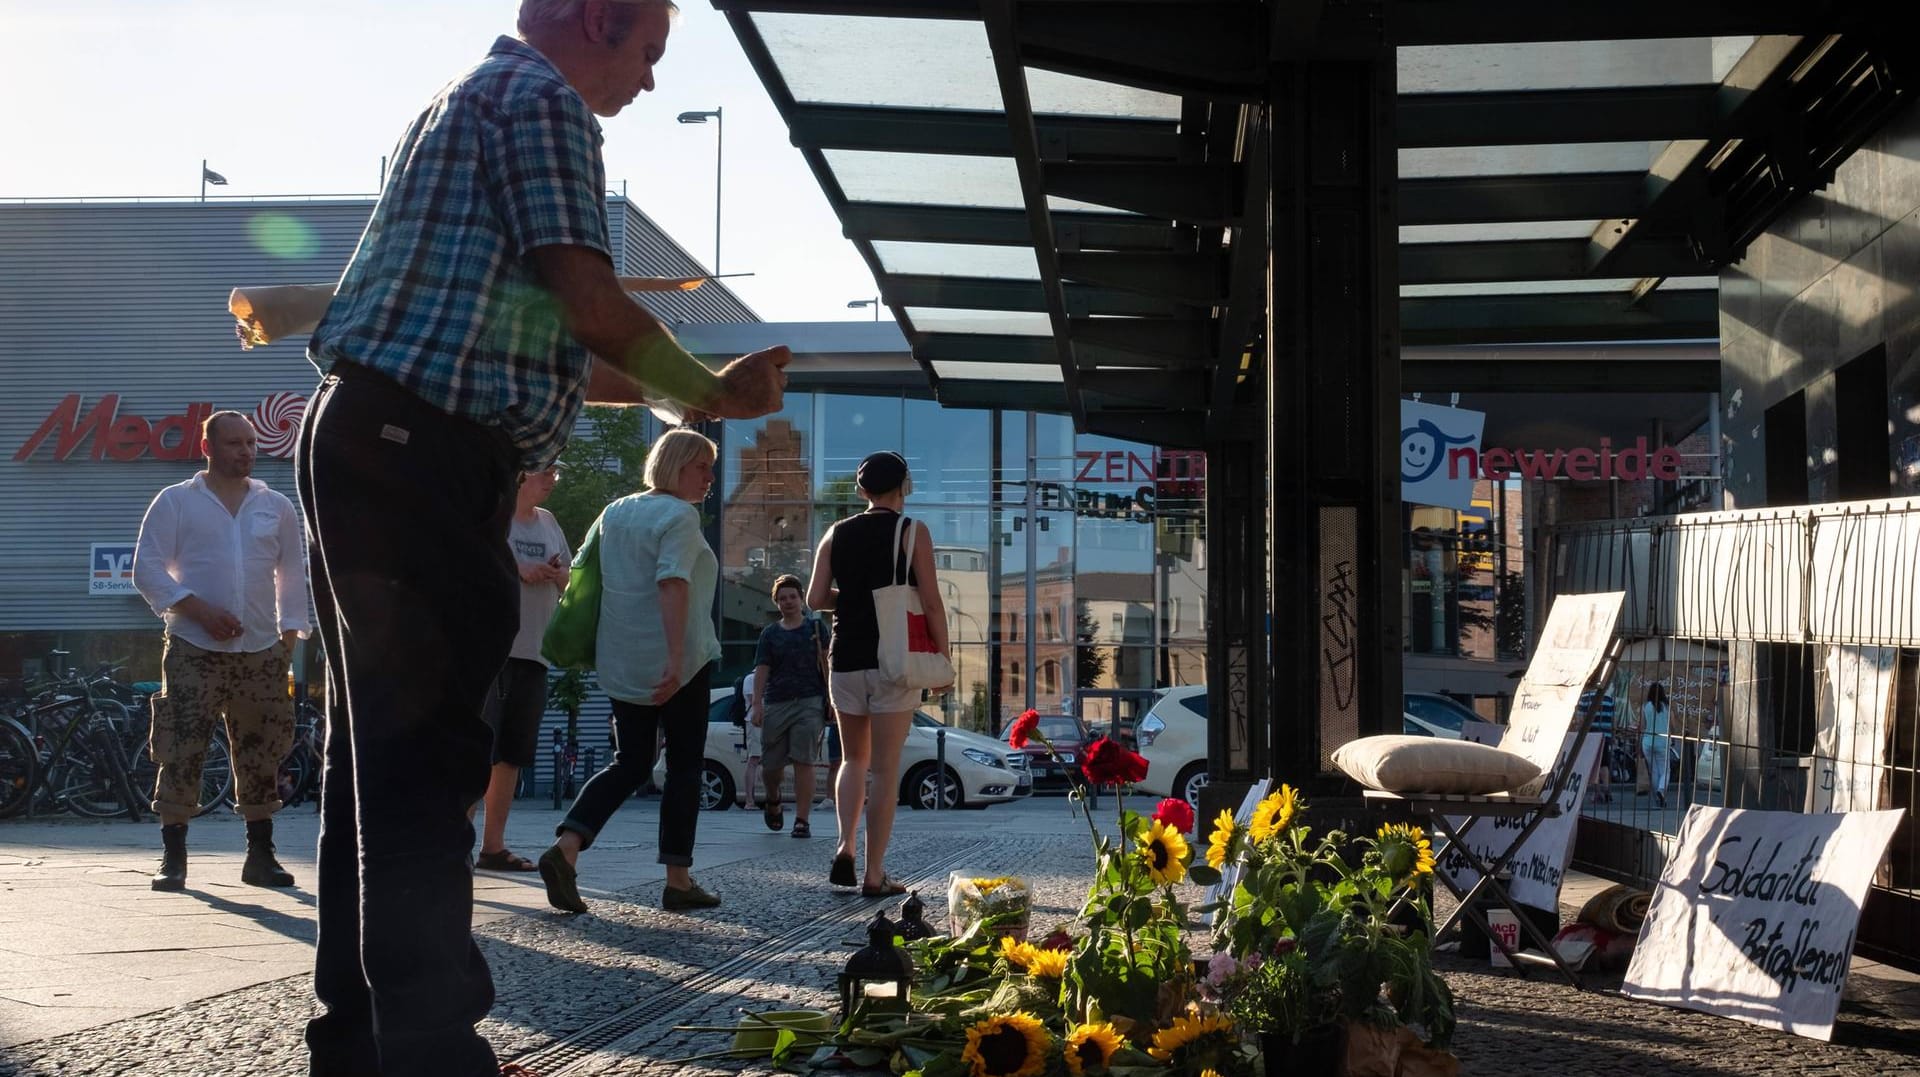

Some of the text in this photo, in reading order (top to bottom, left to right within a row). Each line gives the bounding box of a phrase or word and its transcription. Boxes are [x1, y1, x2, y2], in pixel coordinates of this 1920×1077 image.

[12, 392, 214, 461] Medi
[1075, 451, 1207, 482] ZENTR
[1448, 437, 1682, 480] neweide
[92, 581, 136, 591] SB-Servic
